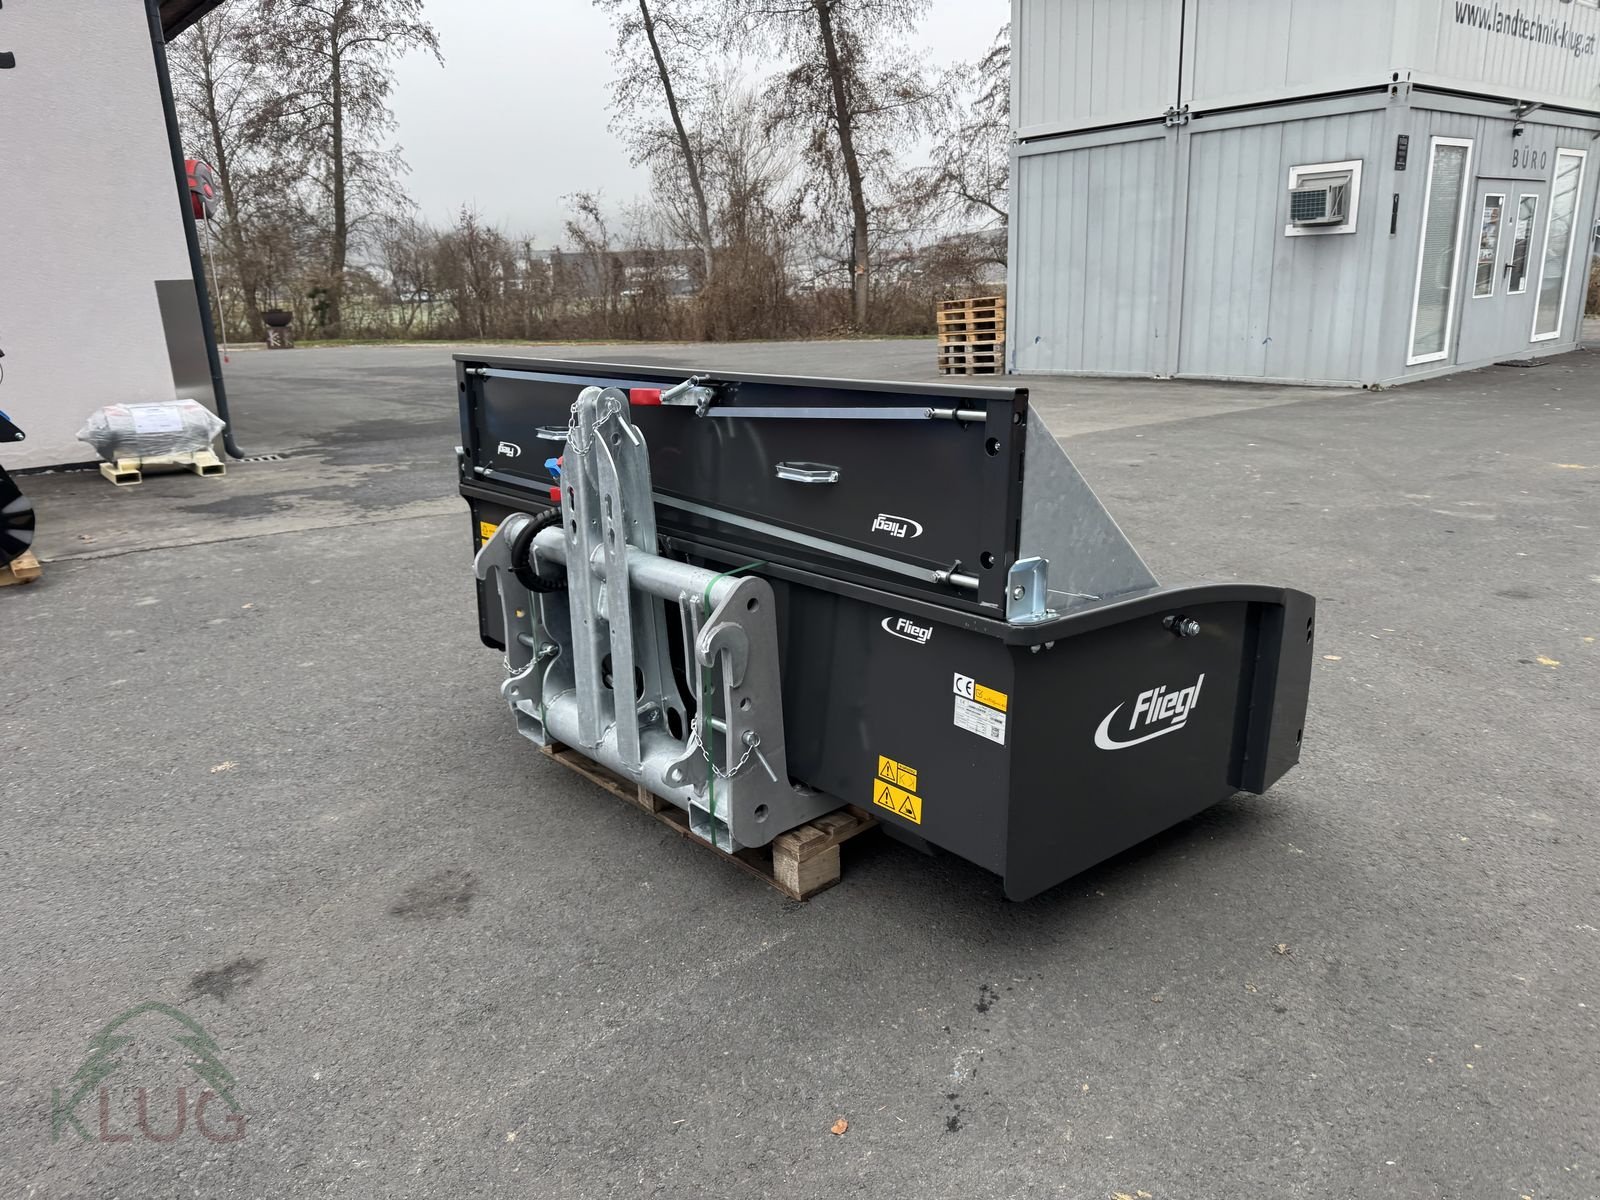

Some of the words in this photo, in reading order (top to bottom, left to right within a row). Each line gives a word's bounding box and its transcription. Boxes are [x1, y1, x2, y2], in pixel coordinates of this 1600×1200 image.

[1512, 145, 1547, 170] BÜRO
[871, 515, 908, 538] Fliegl
[895, 617, 934, 643] Fliegl
[1129, 673, 1205, 731] Fliegl
